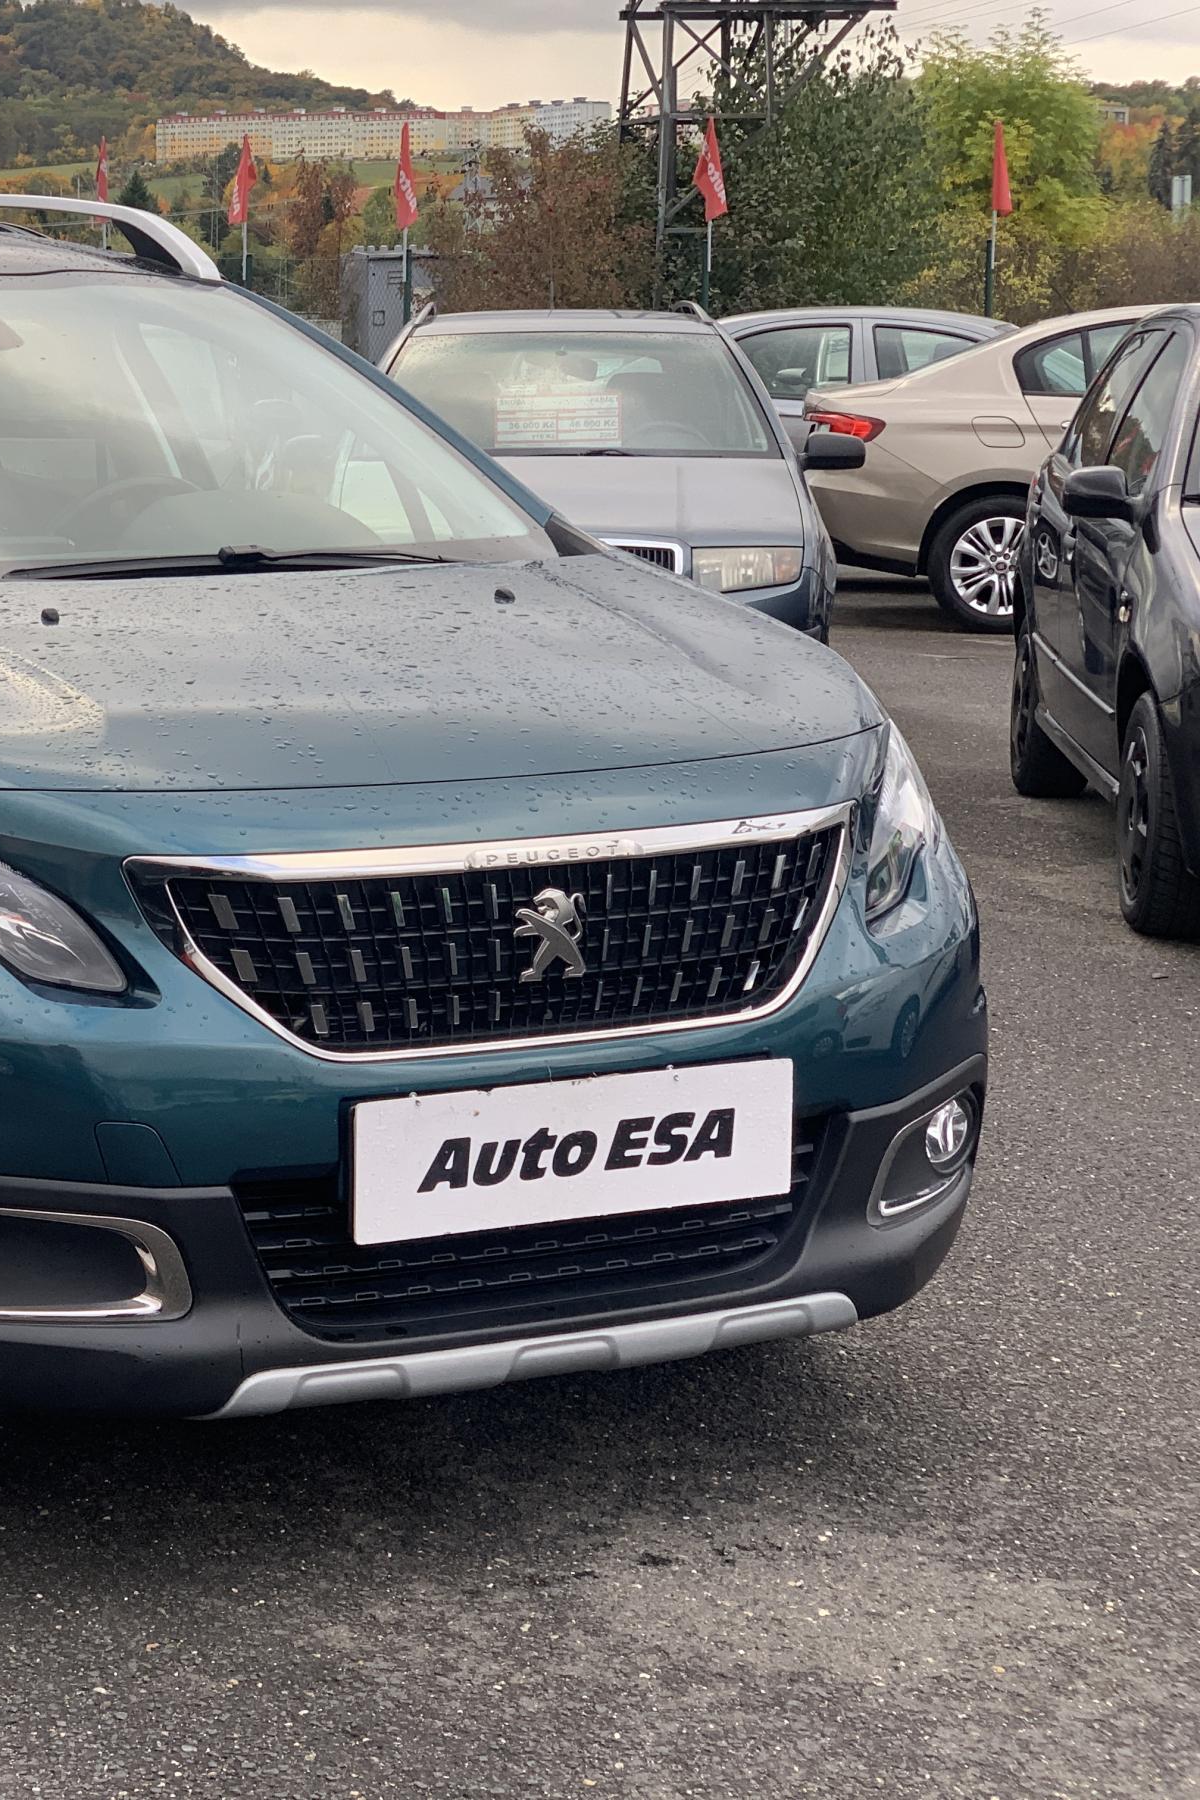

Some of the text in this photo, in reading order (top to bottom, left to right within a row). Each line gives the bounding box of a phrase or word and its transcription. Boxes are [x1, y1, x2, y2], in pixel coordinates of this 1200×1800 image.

[486, 843, 619, 866] PEUGEOT
[416, 1107, 736, 1193] Auto ESA
